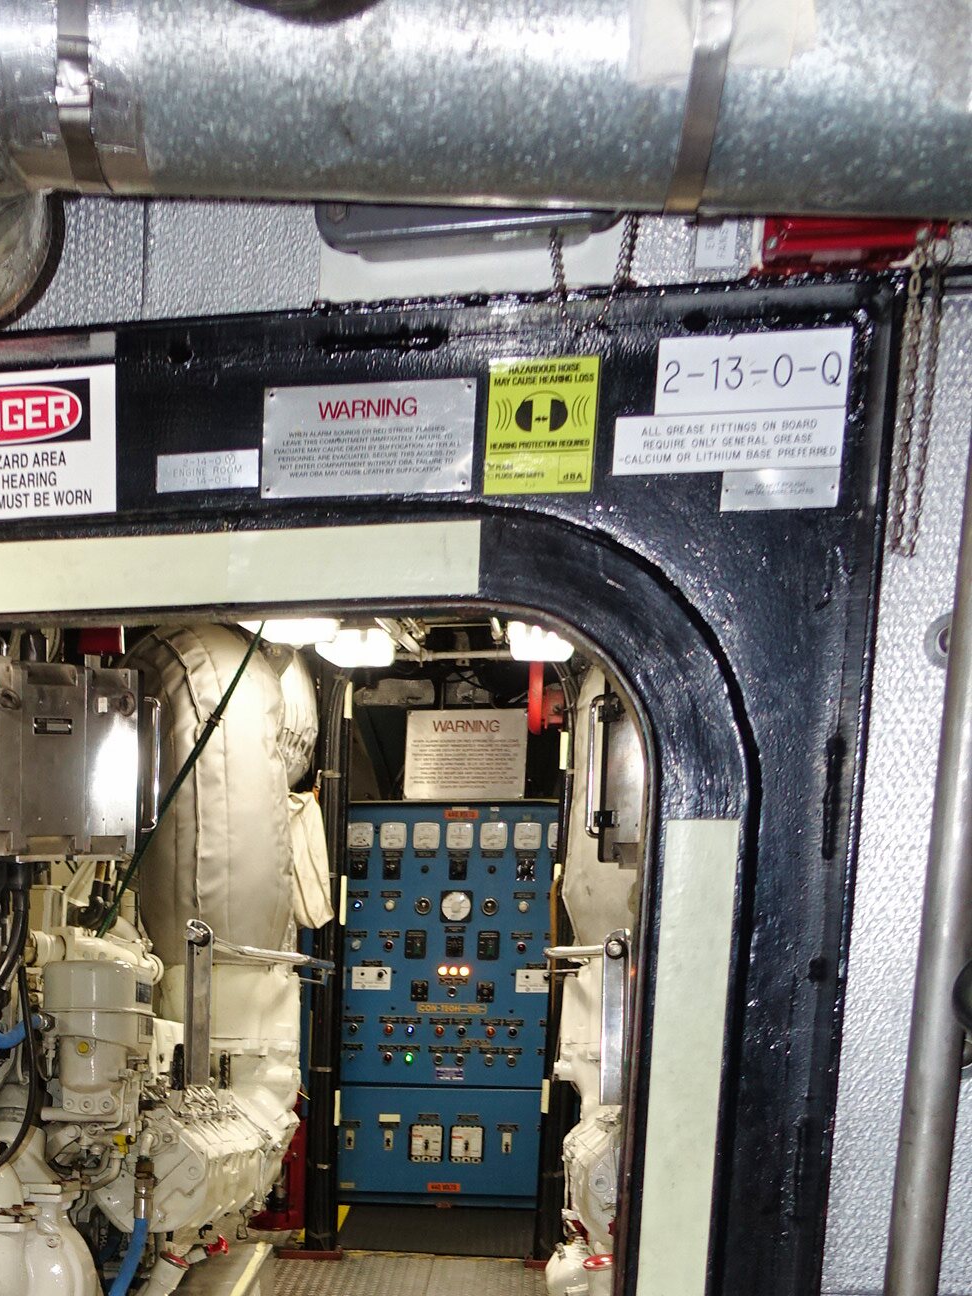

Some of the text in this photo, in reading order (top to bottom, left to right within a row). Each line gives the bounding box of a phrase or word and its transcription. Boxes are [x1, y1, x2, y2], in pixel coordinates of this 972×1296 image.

[509, 362, 580, 374] HAZARDOUS NOISE
[663, 351, 842, 394] 2-13-0-Q
[494, 373, 594, 386] MAY CAUSE HEARING LOSS
[318, 397, 417, 421] WARNING
[642, 418, 818, 437] ALL GREASE FITTINGS ON BOARD
[490, 439, 590, 450] HEARING PROTECTION REQUIRED
[643, 433, 813, 450] REQUIRE ONLY GENERAL GREASE
[32, 451, 66, 468] AREA
[676, 452, 690, 463] OR
[696, 450, 740, 462] LITHIUM
[746, 448, 772, 460] BASE
[778, 445, 836, 458] PREFERRED
[173, 466, 242, 478] ENGINE ROOM
[2, 472, 57, 490] HEARING
[34, 492, 49, 508] BE
[54, 490, 92, 506] WORN
[433, 720, 500, 732] WARNING
